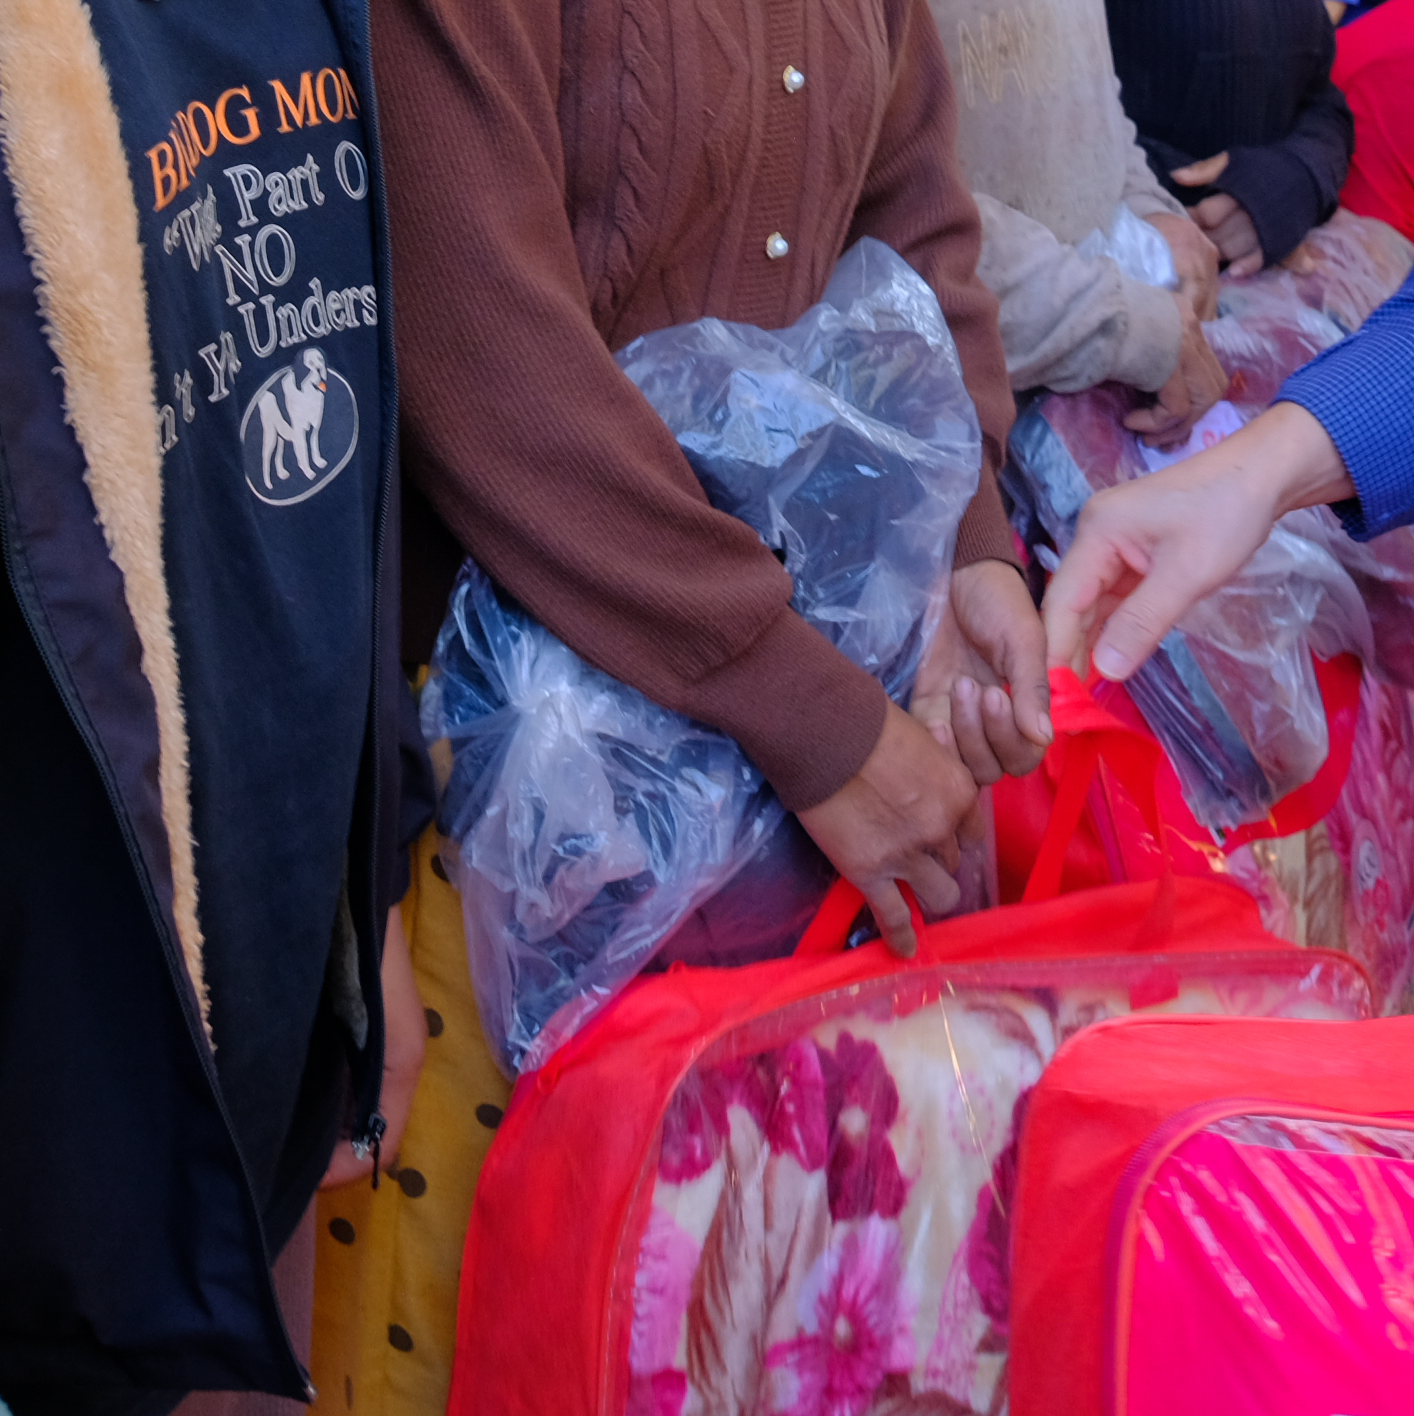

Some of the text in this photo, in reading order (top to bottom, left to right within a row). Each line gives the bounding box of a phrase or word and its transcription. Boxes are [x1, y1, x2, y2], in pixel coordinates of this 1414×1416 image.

[223, 152, 325, 228] Part
[214, 223, 296, 306] NO
[237, 277, 378, 358] Unders
